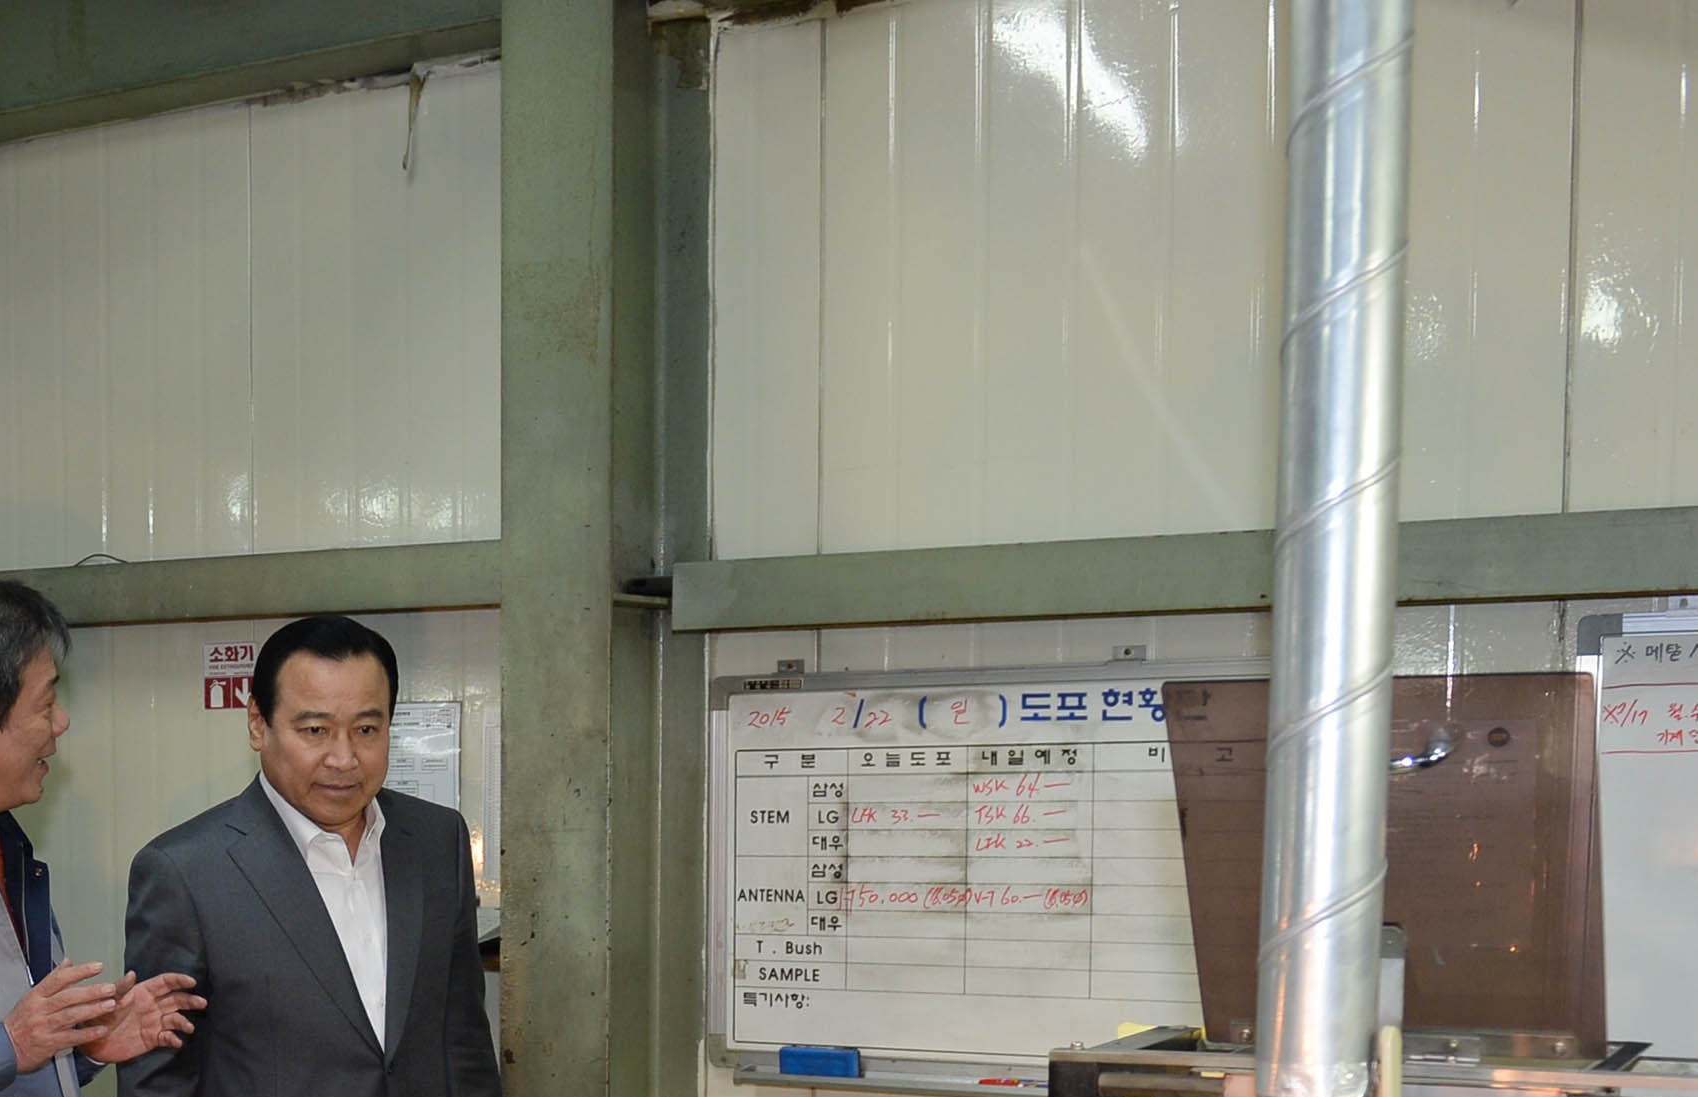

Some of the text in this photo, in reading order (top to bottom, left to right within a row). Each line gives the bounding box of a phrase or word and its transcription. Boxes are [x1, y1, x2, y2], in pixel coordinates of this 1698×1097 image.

[209, 645, 254, 663] 소화기
[748, 707, 791, 728] 2015
[1021, 692, 1087, 721] 도포
[812, 783, 844, 798] 삼성
[750, 810, 790, 824] STEM
[818, 810, 839, 824] LG
[812, 835, 843, 851] 대우
[811, 863, 843, 879] 삼성
[737, 888, 805, 903] ANTENNA
[817, 891, 838, 904] LG
[811, 916, 842, 931] 대우
[785, 941, 823, 955] Bush
[758, 967, 820, 982] SAMPLE
